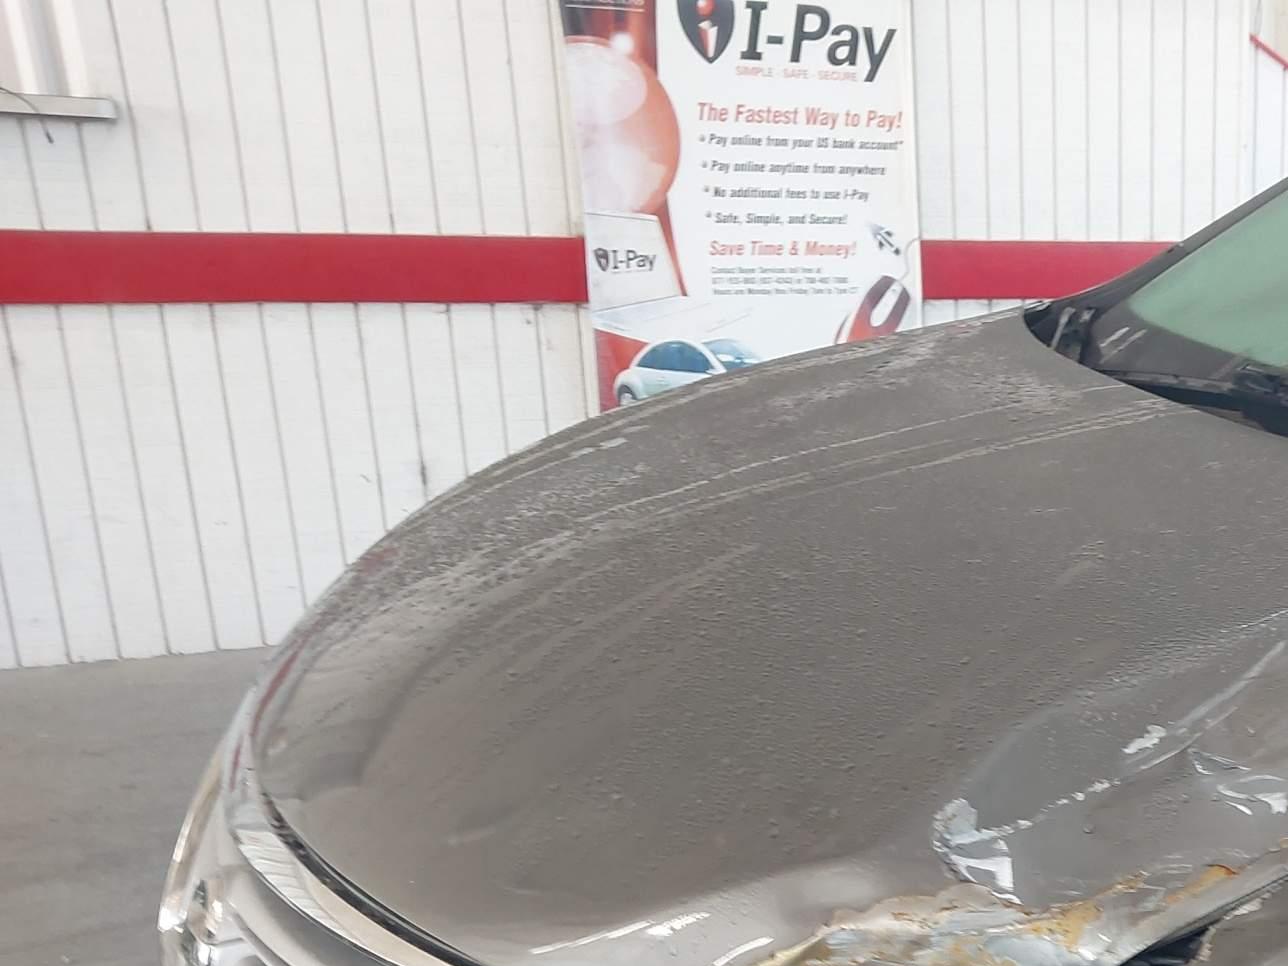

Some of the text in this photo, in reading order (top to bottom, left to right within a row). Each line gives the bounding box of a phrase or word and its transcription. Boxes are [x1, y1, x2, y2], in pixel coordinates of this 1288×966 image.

[740, 1, 897, 82] I-Pay
[698, 103, 903, 133] The Fastest Way to Pay!
[708, 134, 727, 147] Pay
[731, 136, 762, 147] online
[766, 137, 788, 148] from
[792, 139, 814, 150] your
[832, 140, 855, 150] bank
[710, 160, 886, 177] Pay online anytime from anywhere
[713, 187, 726, 198] No
[730, 187, 783, 199] additional
[786, 189, 807, 199] fees
[810, 190, 820, 199] to
[824, 191, 840, 199] use
[746, 213, 784, 226] Simple,
[788, 214, 806, 224] and
[809, 214, 848, 225] Secure!
[709, 240, 858, 259] Save Time & Money!
[611, 249, 656, 271] I-Pay
